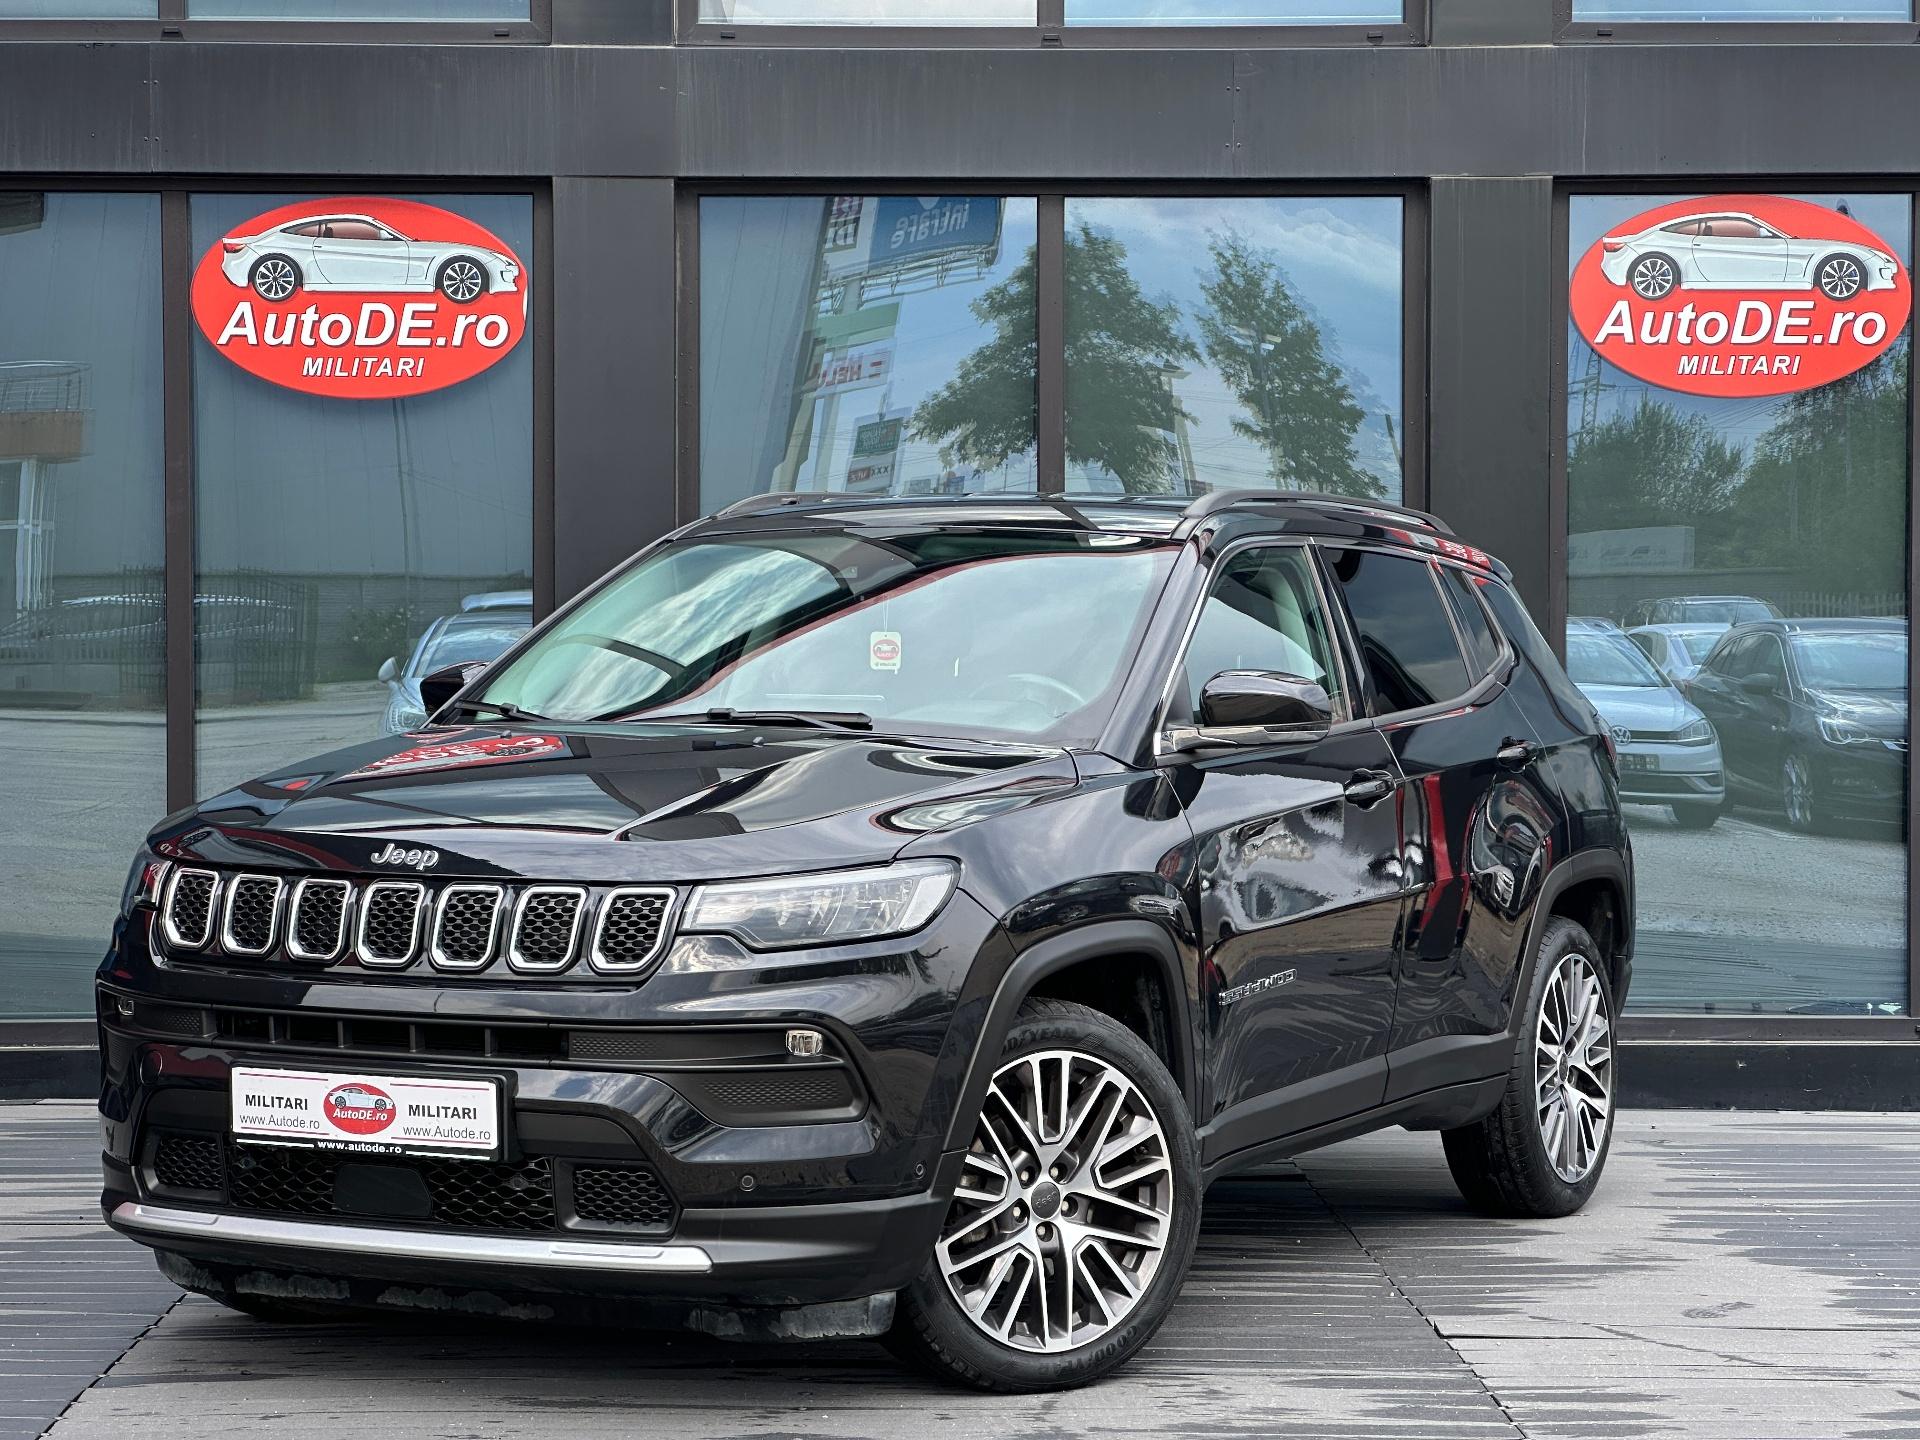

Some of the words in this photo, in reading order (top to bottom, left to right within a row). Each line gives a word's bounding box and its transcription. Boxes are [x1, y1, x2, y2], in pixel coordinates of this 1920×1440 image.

[217, 301, 509, 348] AutoDE.ro
[1595, 300, 1888, 346] AutoDE.ro
[301, 356, 425, 378] MILITARI
[1677, 354, 1802, 376] MILITARI
[371, 843, 439, 871] Jeep
[245, 1094, 309, 1111] MILITARI
[332, 1108, 388, 1122] AutoDE.ro
[408, 1104, 478, 1120] MILITARI
[240, 1113, 320, 1130] www.Autode.ro
[402, 1124, 491, 1141] www.Autode.ro
[317, 1140, 402, 1154] www.autode.ro
